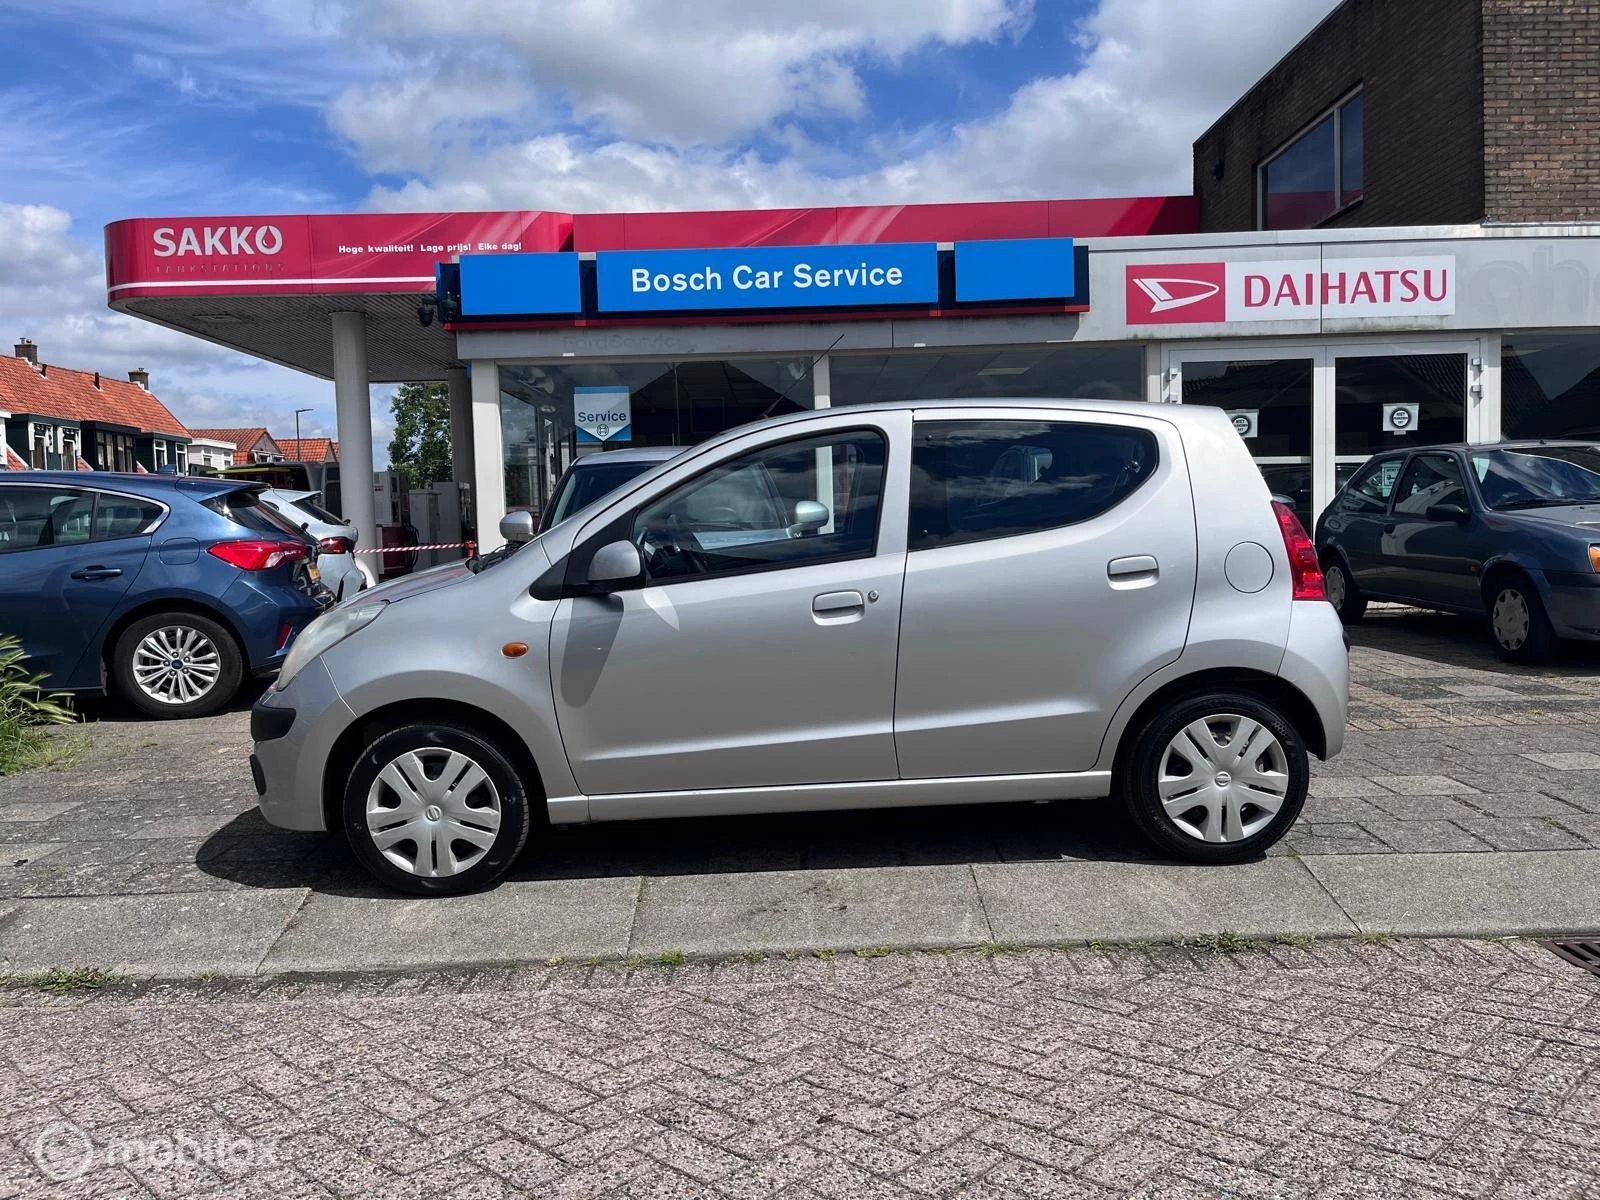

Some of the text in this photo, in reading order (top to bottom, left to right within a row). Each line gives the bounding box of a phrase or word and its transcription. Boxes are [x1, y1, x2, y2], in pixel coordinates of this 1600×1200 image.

[153, 225, 283, 257] SAKKO
[338, 241, 522, 255] Hoge kwaliteit! Lage prijs! Elke dag!
[631, 262, 902, 293] Bosch Car Service
[1244, 269, 1448, 308] DAIHATSU
[578, 410, 627, 422] Service
